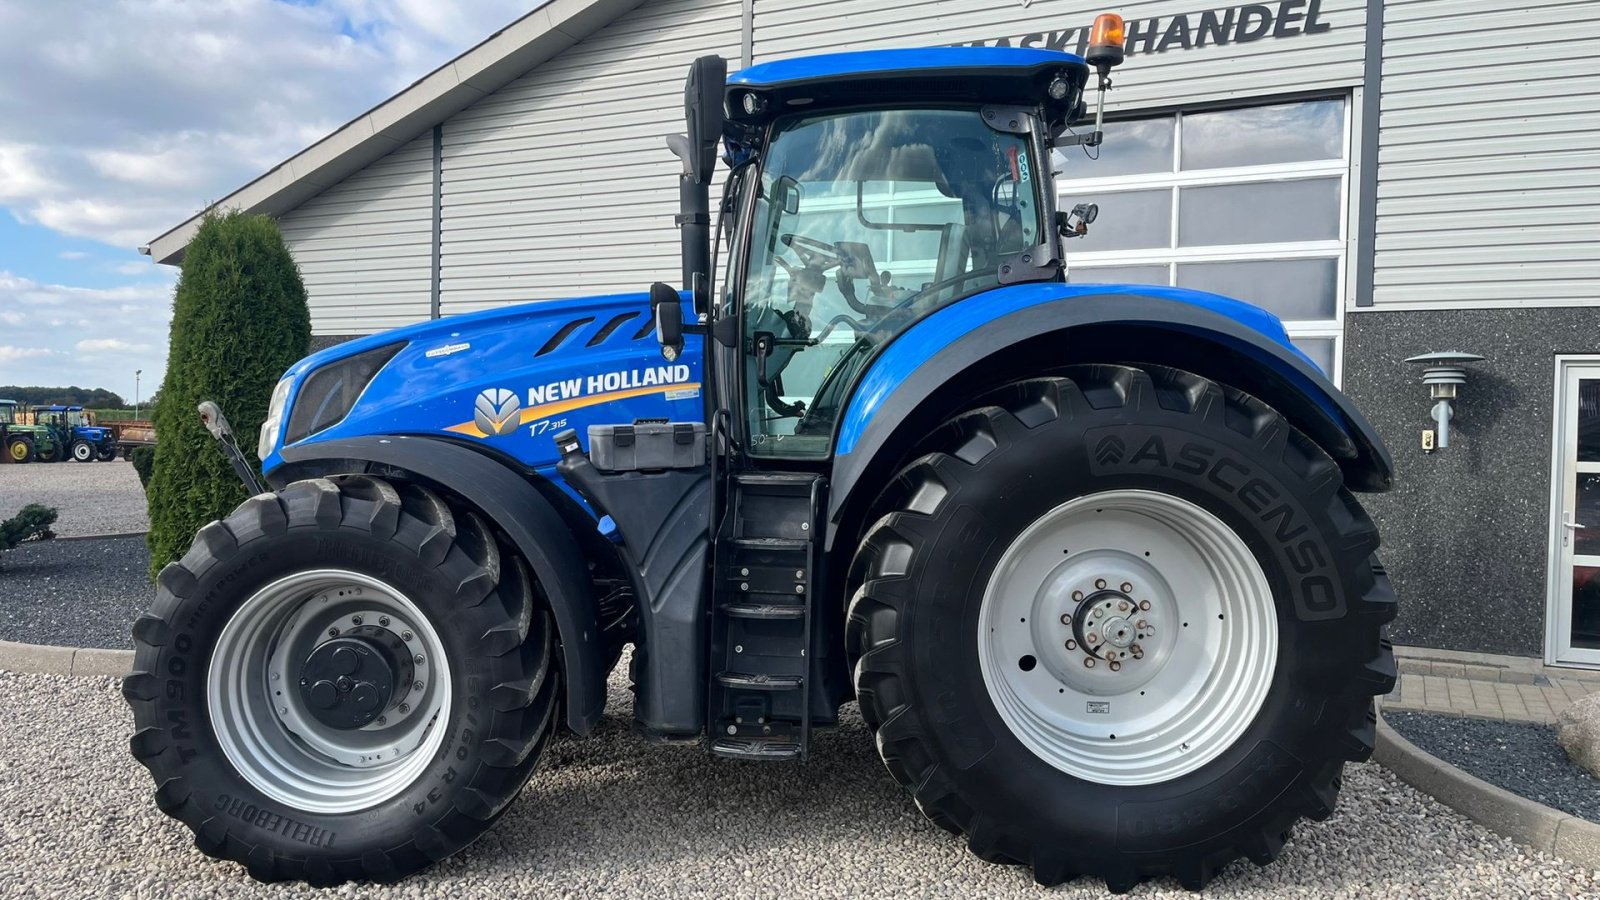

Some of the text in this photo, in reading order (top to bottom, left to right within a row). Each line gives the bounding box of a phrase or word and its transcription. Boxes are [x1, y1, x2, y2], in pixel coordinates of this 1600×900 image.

[945, 0, 1330, 58] SKIHANDEL
[528, 364, 690, 406] NEW HOLLAND
[1128, 435, 1337, 612] ASCENSO
[166, 632, 193, 701] 900
[166, 710, 197, 765] TM
[213, 793, 337, 849] TRELLEBORG
